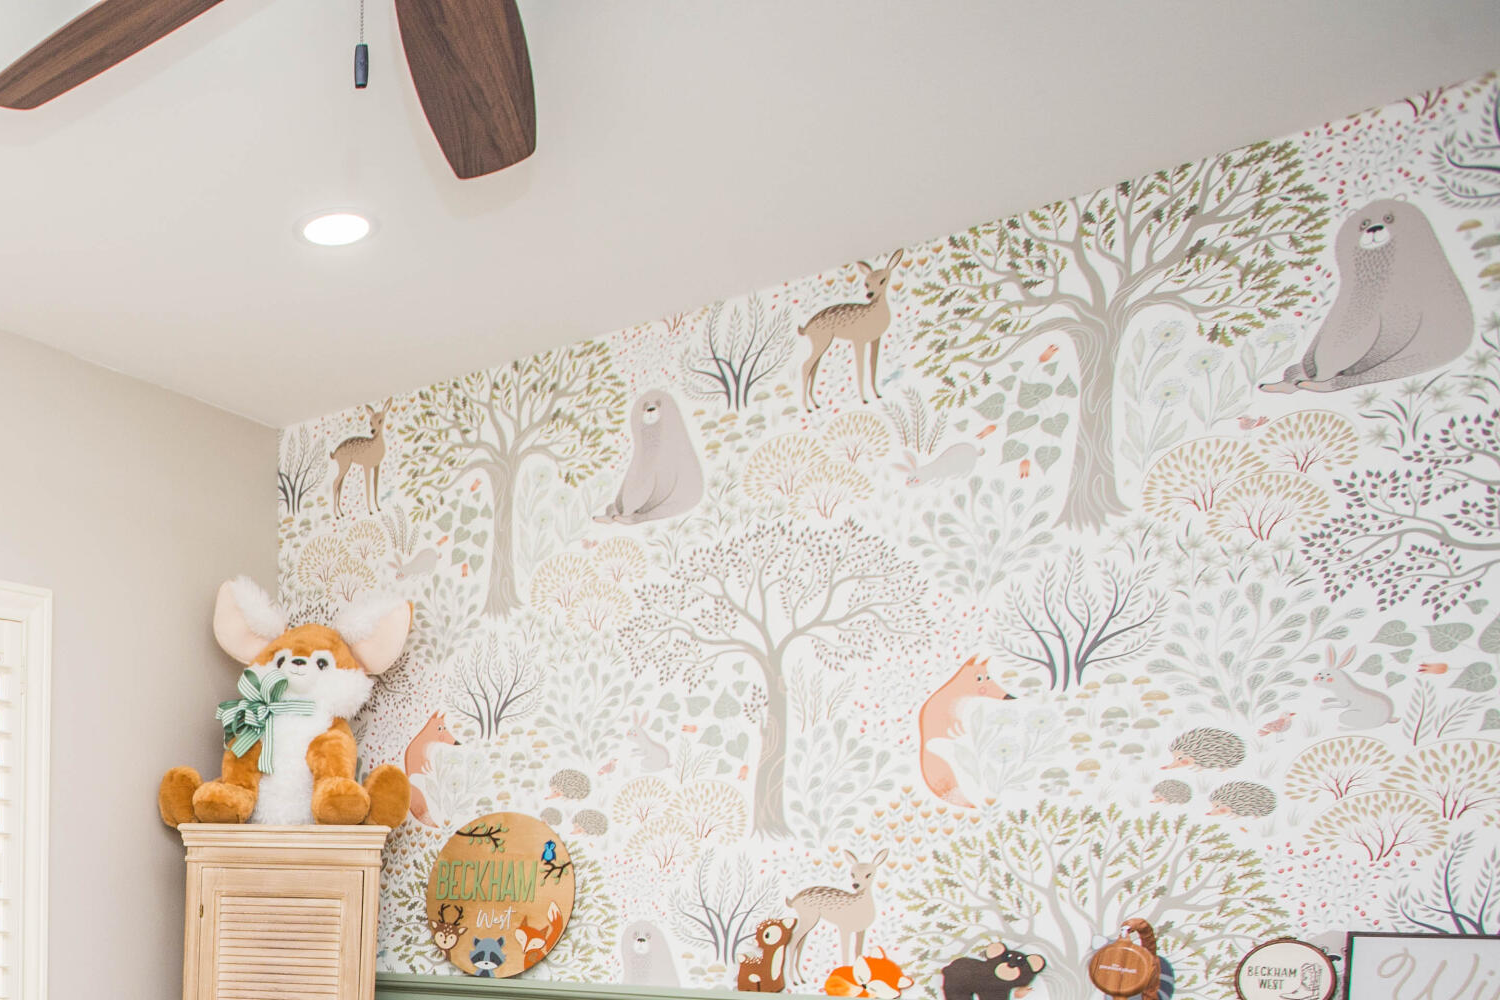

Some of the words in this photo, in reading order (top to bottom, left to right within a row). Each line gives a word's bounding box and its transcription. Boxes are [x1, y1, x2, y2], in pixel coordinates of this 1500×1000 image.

[436, 860, 538, 903] BECKHAM
[476, 906, 516, 930] West
[1247, 965, 1298, 978] BECKHAM
[1258, 978, 1285, 991] WEST
